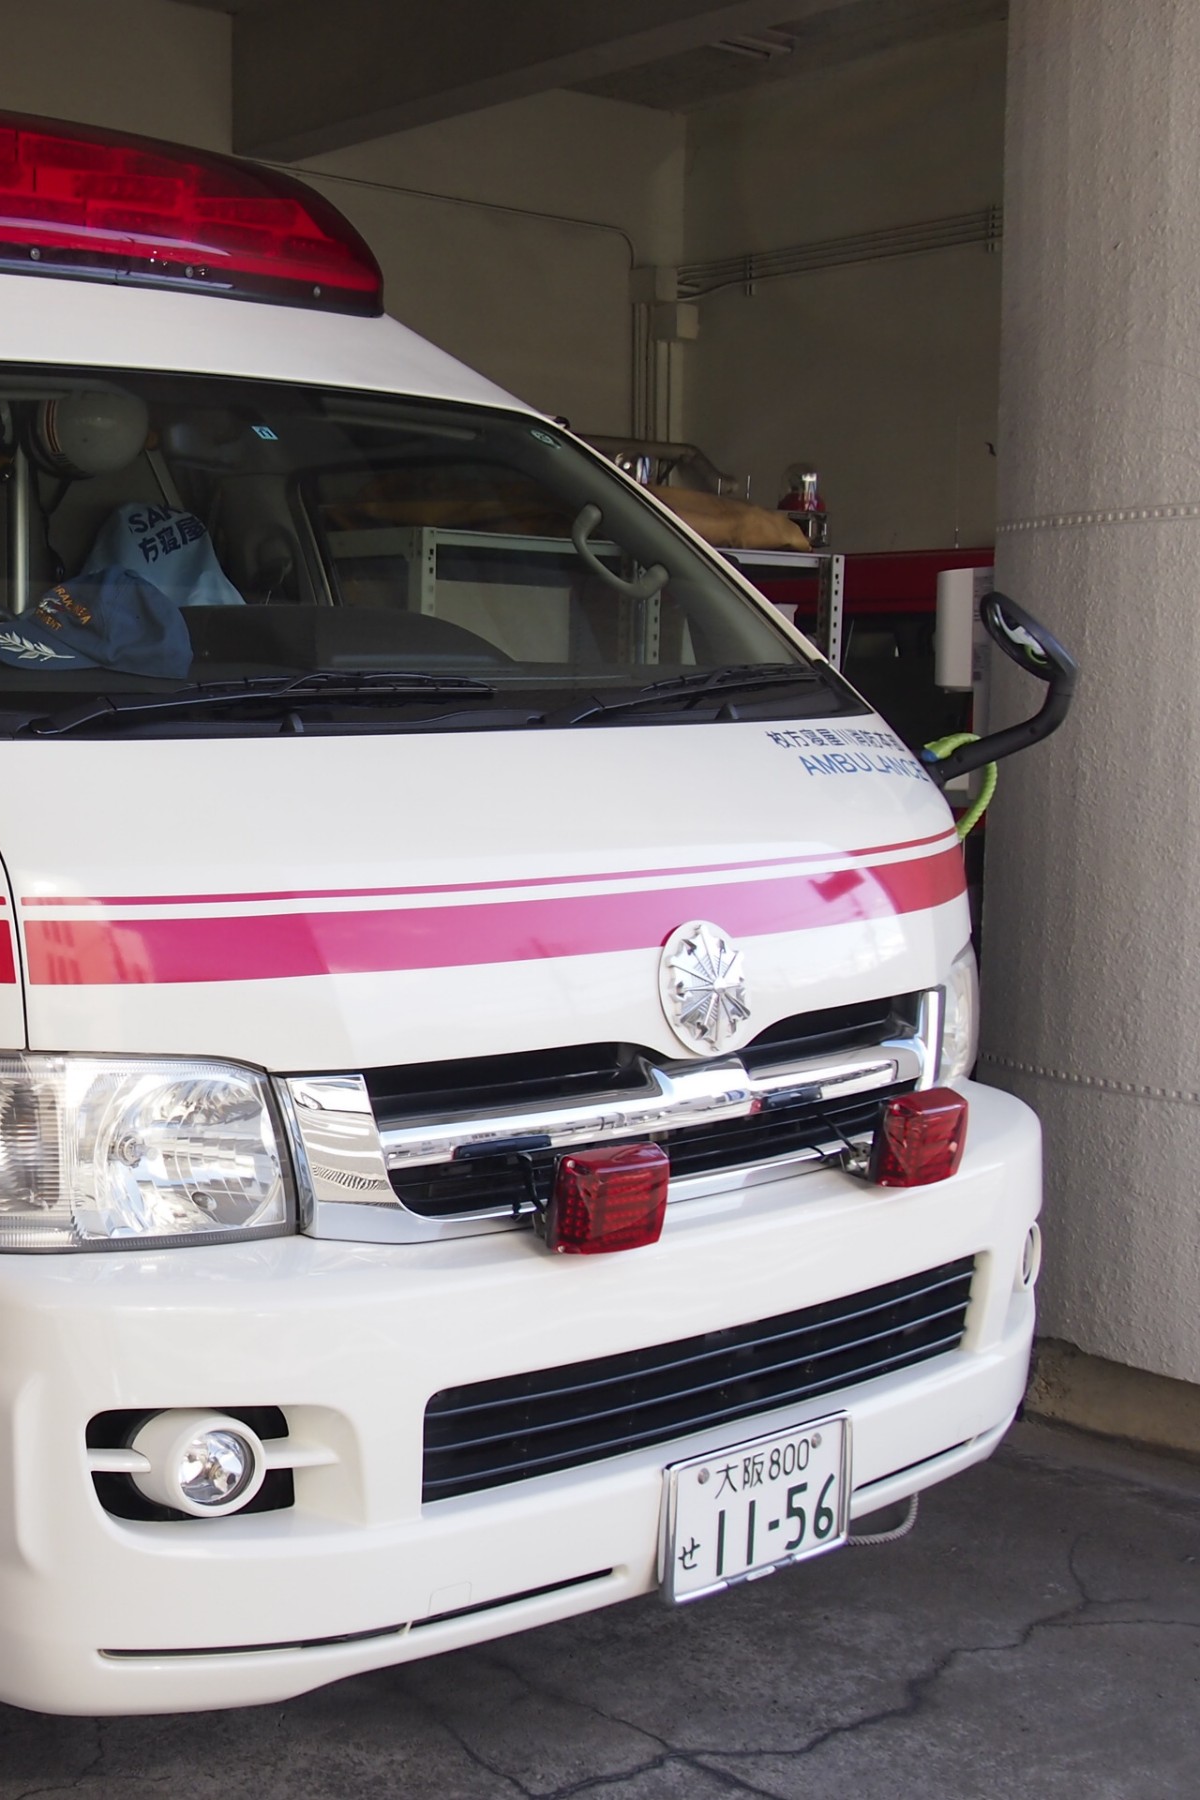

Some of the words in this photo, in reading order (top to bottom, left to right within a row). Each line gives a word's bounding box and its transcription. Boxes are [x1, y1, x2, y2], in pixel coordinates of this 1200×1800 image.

[127, 504, 183, 534] SAK
[799, 753, 930, 782] AMBULANCE
[678, 1537, 700, 1570] せ
[715, 1473, 836, 1577] 11-56
